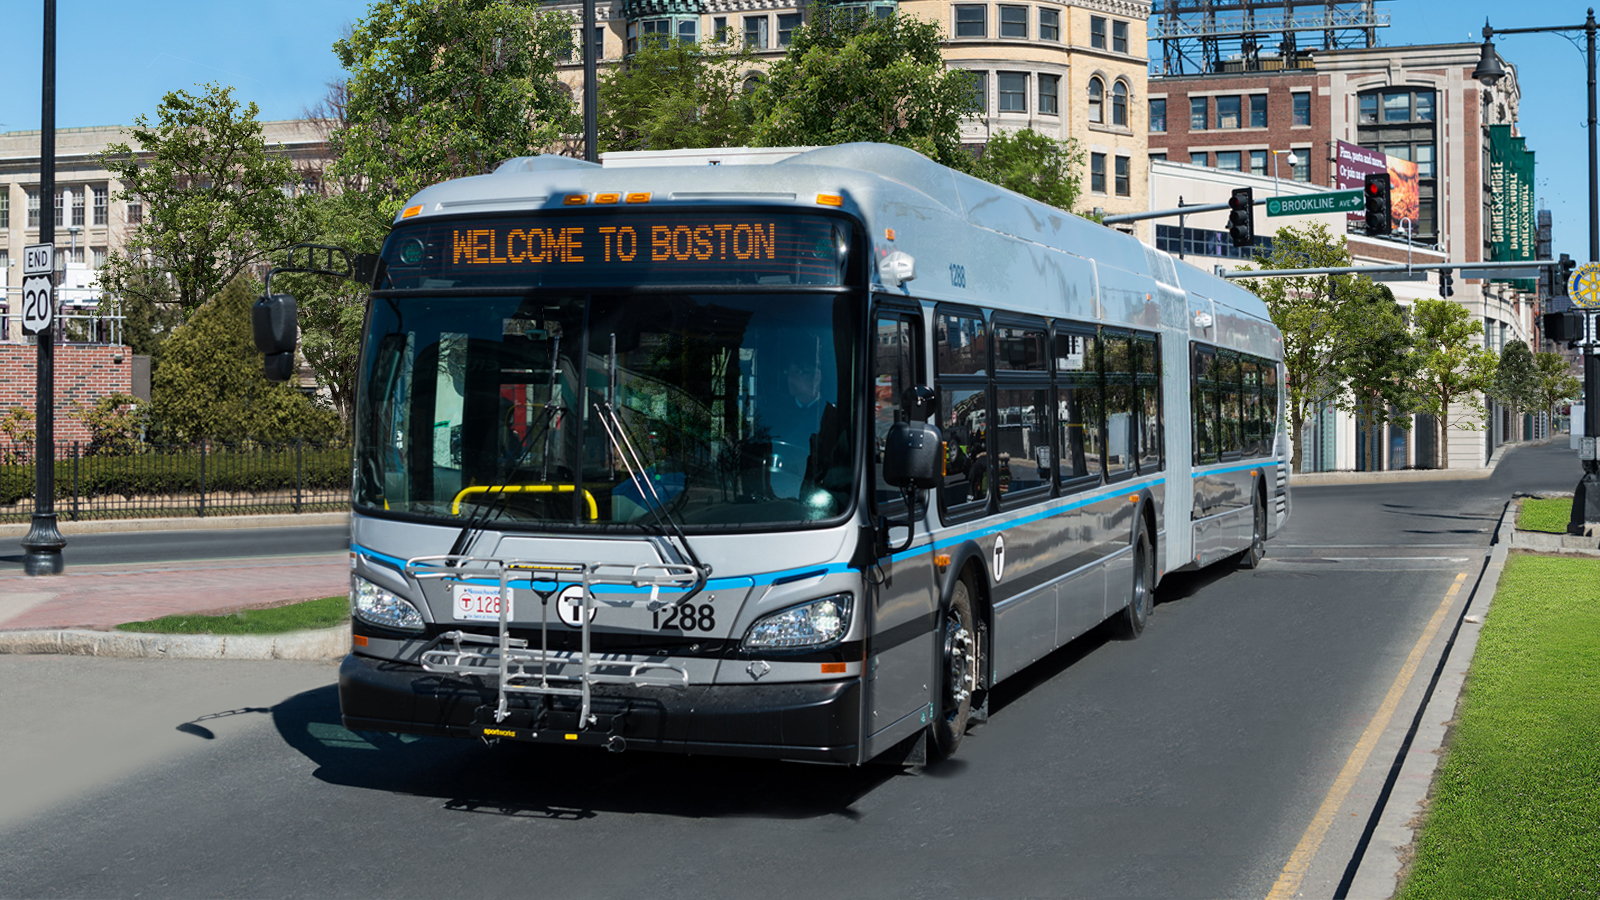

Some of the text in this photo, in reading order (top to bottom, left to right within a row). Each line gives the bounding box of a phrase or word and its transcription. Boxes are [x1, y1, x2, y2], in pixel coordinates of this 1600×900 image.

[1352, 151, 1363, 163] pasta
[1363, 153, 1372, 164] and
[1340, 164, 1346, 176] Or
[1347, 166, 1355, 179] join
[1282, 198, 1334, 211] BROOKLINE
[453, 223, 775, 263] WELCOME TO BOSTON
[28, 251, 48, 268] END
[949, 263, 966, 288] 1288
[26, 289, 48, 321] 20
[996, 546, 1003, 575] T
[462, 598, 471, 608] T
[653, 603, 715, 631] 1288
[483, 728, 516, 737] sportworks
